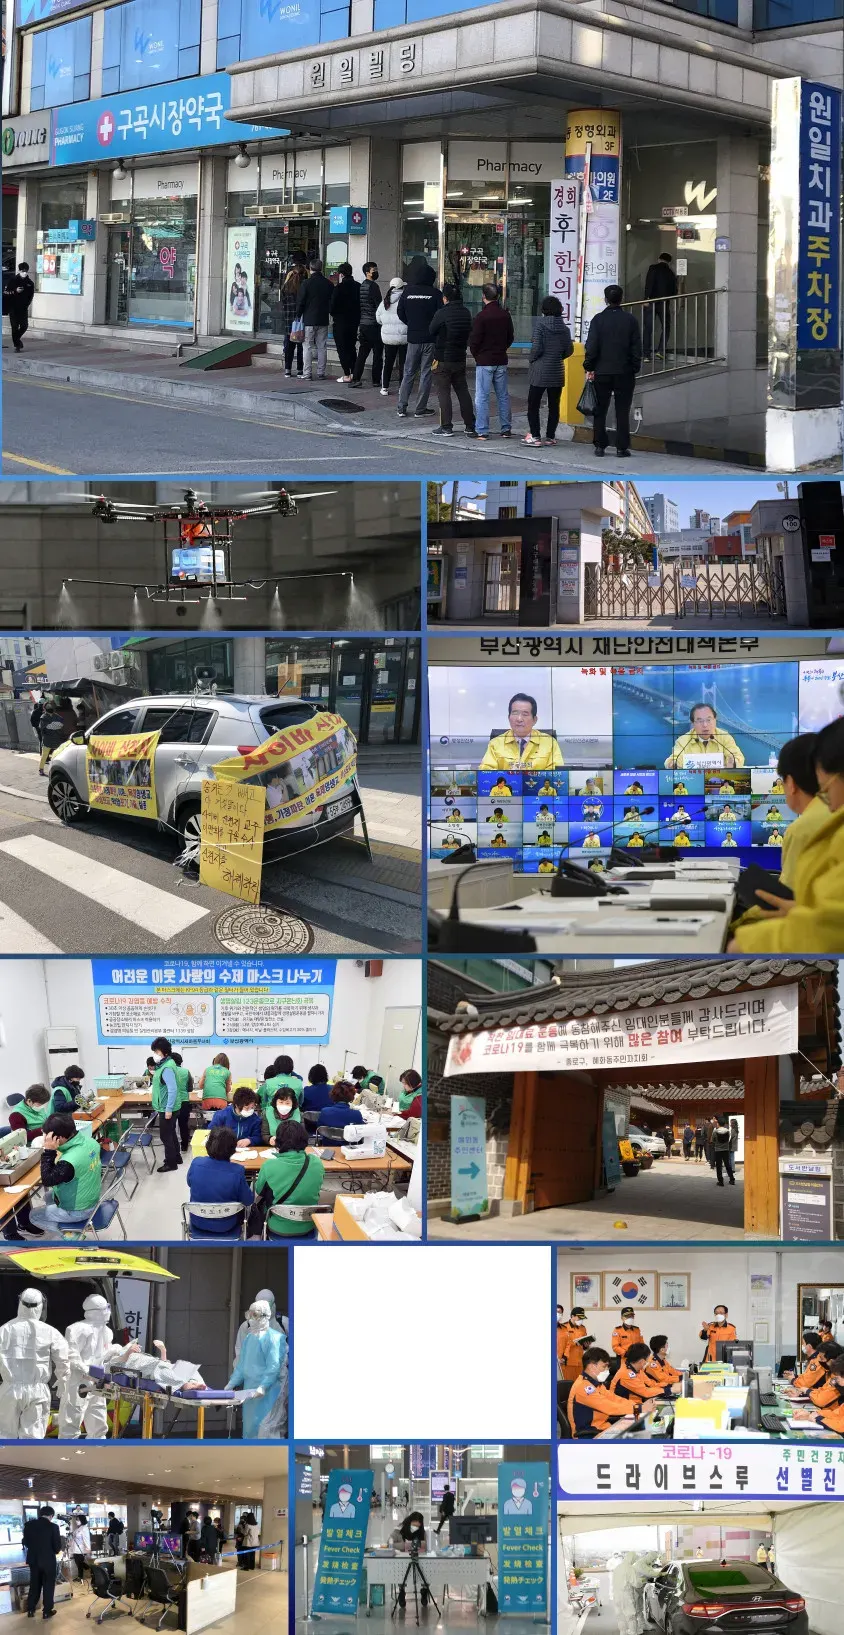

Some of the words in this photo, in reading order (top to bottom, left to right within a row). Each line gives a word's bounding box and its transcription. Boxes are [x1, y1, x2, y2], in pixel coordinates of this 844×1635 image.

[311, 43, 416, 88] 원일빌딩
[117, 91, 224, 141] 구곡시장약국
[574, 125, 617, 138] 정형외과
[54, 132, 84, 146] PHARMACY
[604, 142, 616, 152] 3F
[477, 158, 543, 175] Pharmacy
[157, 178, 185, 190] Pharmacy
[603, 190, 614, 200] 2F
[470, 247, 484, 256] 구곡
[159, 246, 177, 279] 약
[460, 256, 488, 265] 시장약국
[112, 968, 148, 984] 어려운
[152, 968, 176, 984] 이웃
[179, 968, 216, 984] 사랑의
[219, 968, 244, 984] 수제
[247, 968, 284, 984] 마스크
[286, 968, 322, 984] 나누기
[538, 1026, 568, 1040] 운동에
[571, 1018, 622, 1036] 동참해주신
[625, 1010, 695, 1032] 임대인분들께
[698, 998, 766, 1023] 감사드리며
[482, 1042, 533, 1056] 코로나19를
[536, 1040, 556, 1052] 함께
[559, 1038, 600, 1051] 극복하기
[604, 1036, 624, 1048] 위해
[628, 1032, 653, 1048] 많은
[656, 1028, 683, 1046] 참여
[688, 1018, 772, 1042] 부탁드립니다.
[566, 1058, 588, 1066] 종로구,
[592, 1053, 648, 1066] 혜화동주민자치회
[662, 1445, 704, 1460] 코로나
[709, 1446, 732, 1460] -19
[596, 1464, 748, 1490] 드라이브스루
[776, 1466, 836, 1492] 선별진
[326, 1528, 362, 1539] 발열체크
[502, 1526, 544, 1536] 발열체크
[324, 1545, 341, 1553] Fever
